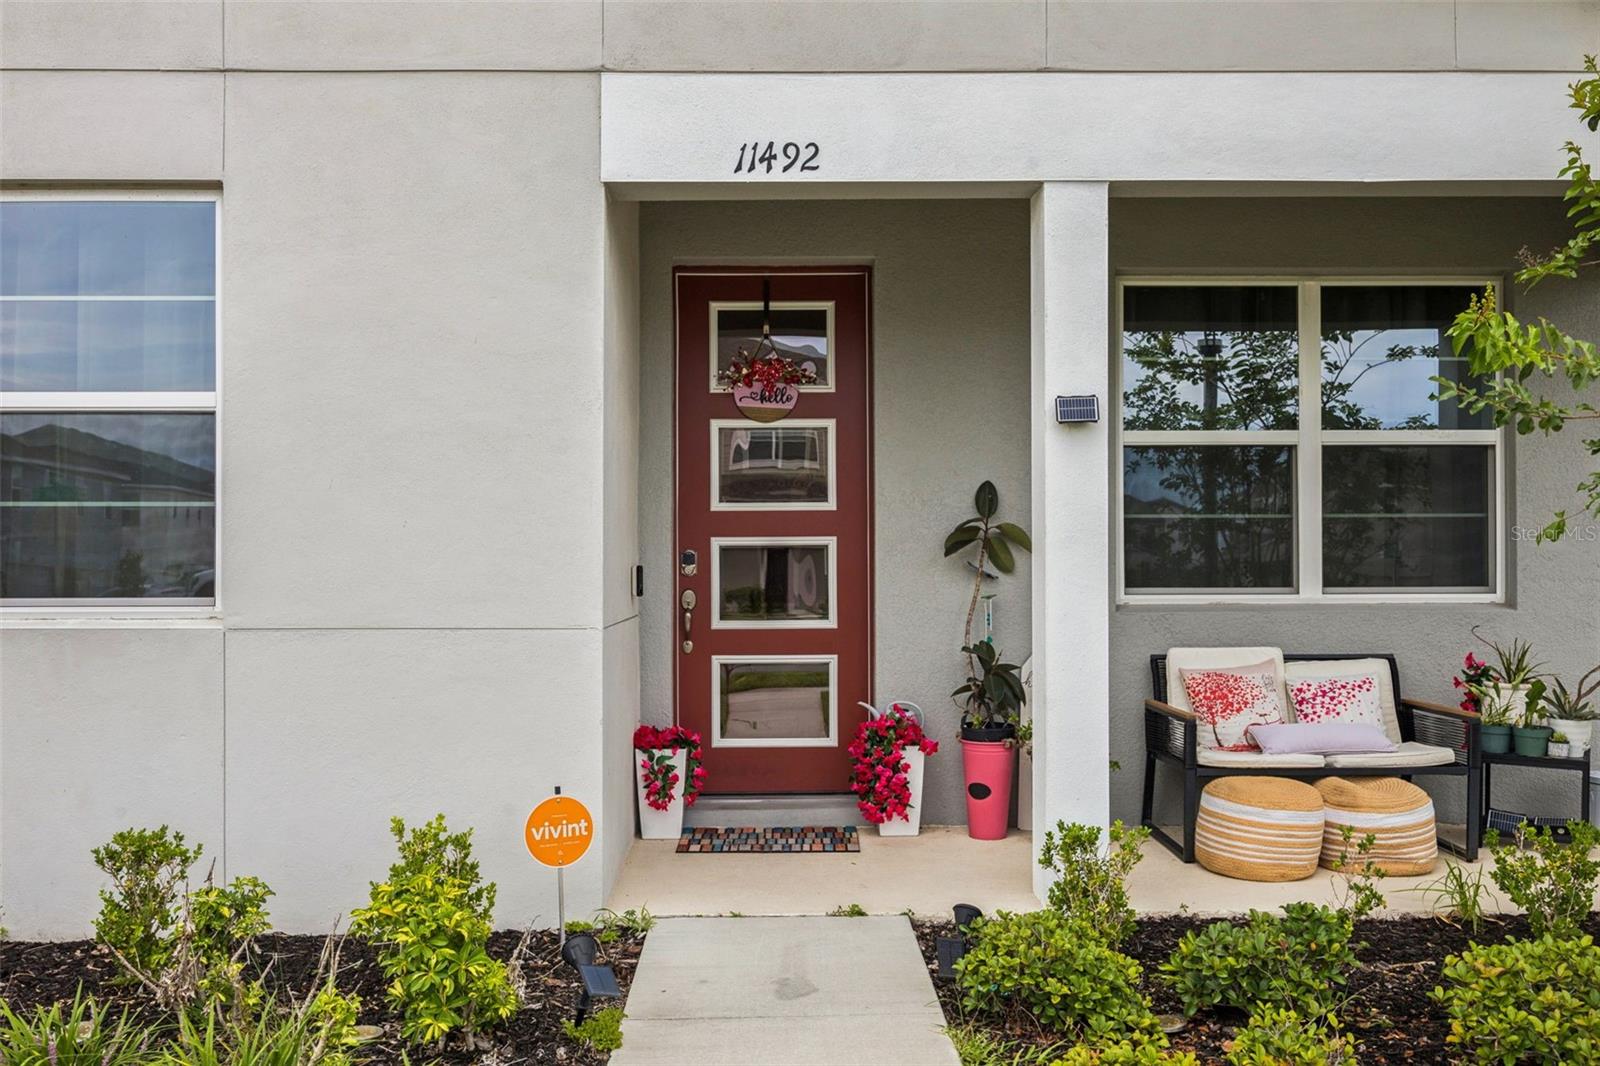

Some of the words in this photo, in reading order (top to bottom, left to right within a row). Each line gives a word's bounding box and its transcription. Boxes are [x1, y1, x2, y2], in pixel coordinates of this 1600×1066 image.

[733, 141, 820, 174] 11492
[760, 386, 793, 404] hello
[531, 818, 588, 841] vivint
